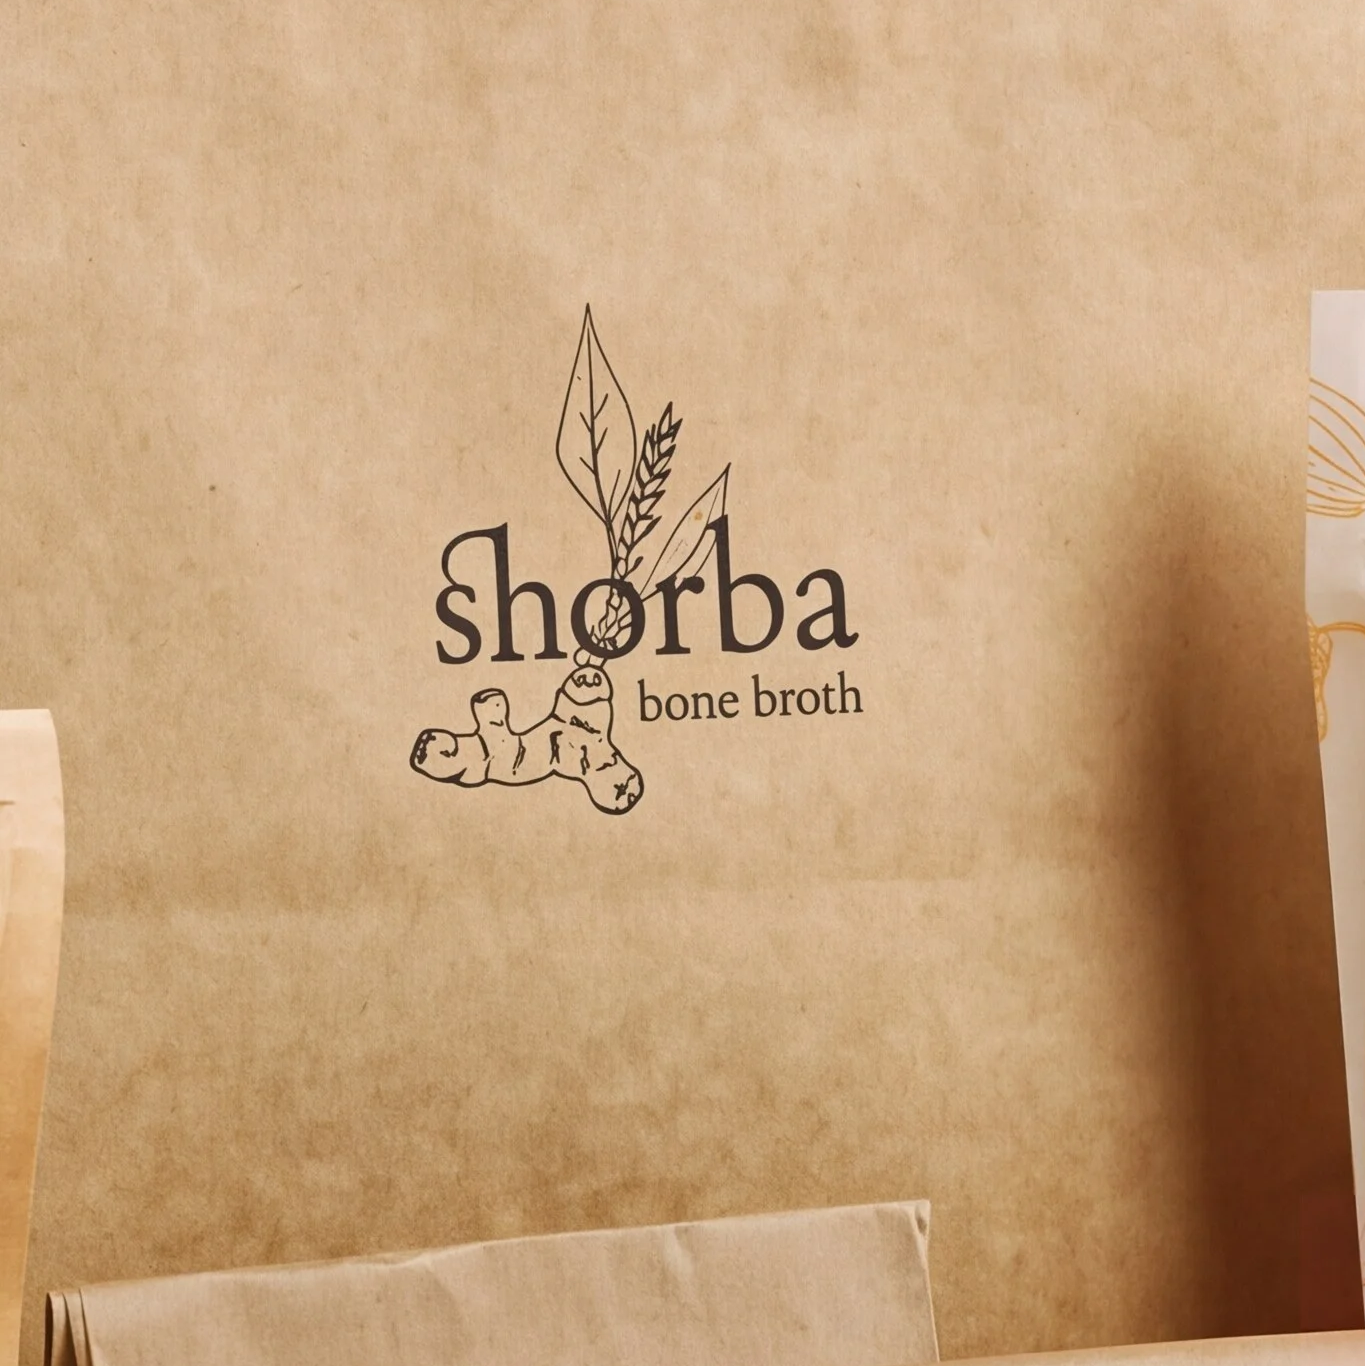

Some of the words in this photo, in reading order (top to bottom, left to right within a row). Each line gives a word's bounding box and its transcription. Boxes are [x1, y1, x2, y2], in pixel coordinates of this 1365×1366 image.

[434, 515, 860, 666] shorba
[637, 678, 740, 722] bone
[751, 670, 864, 718] broth
